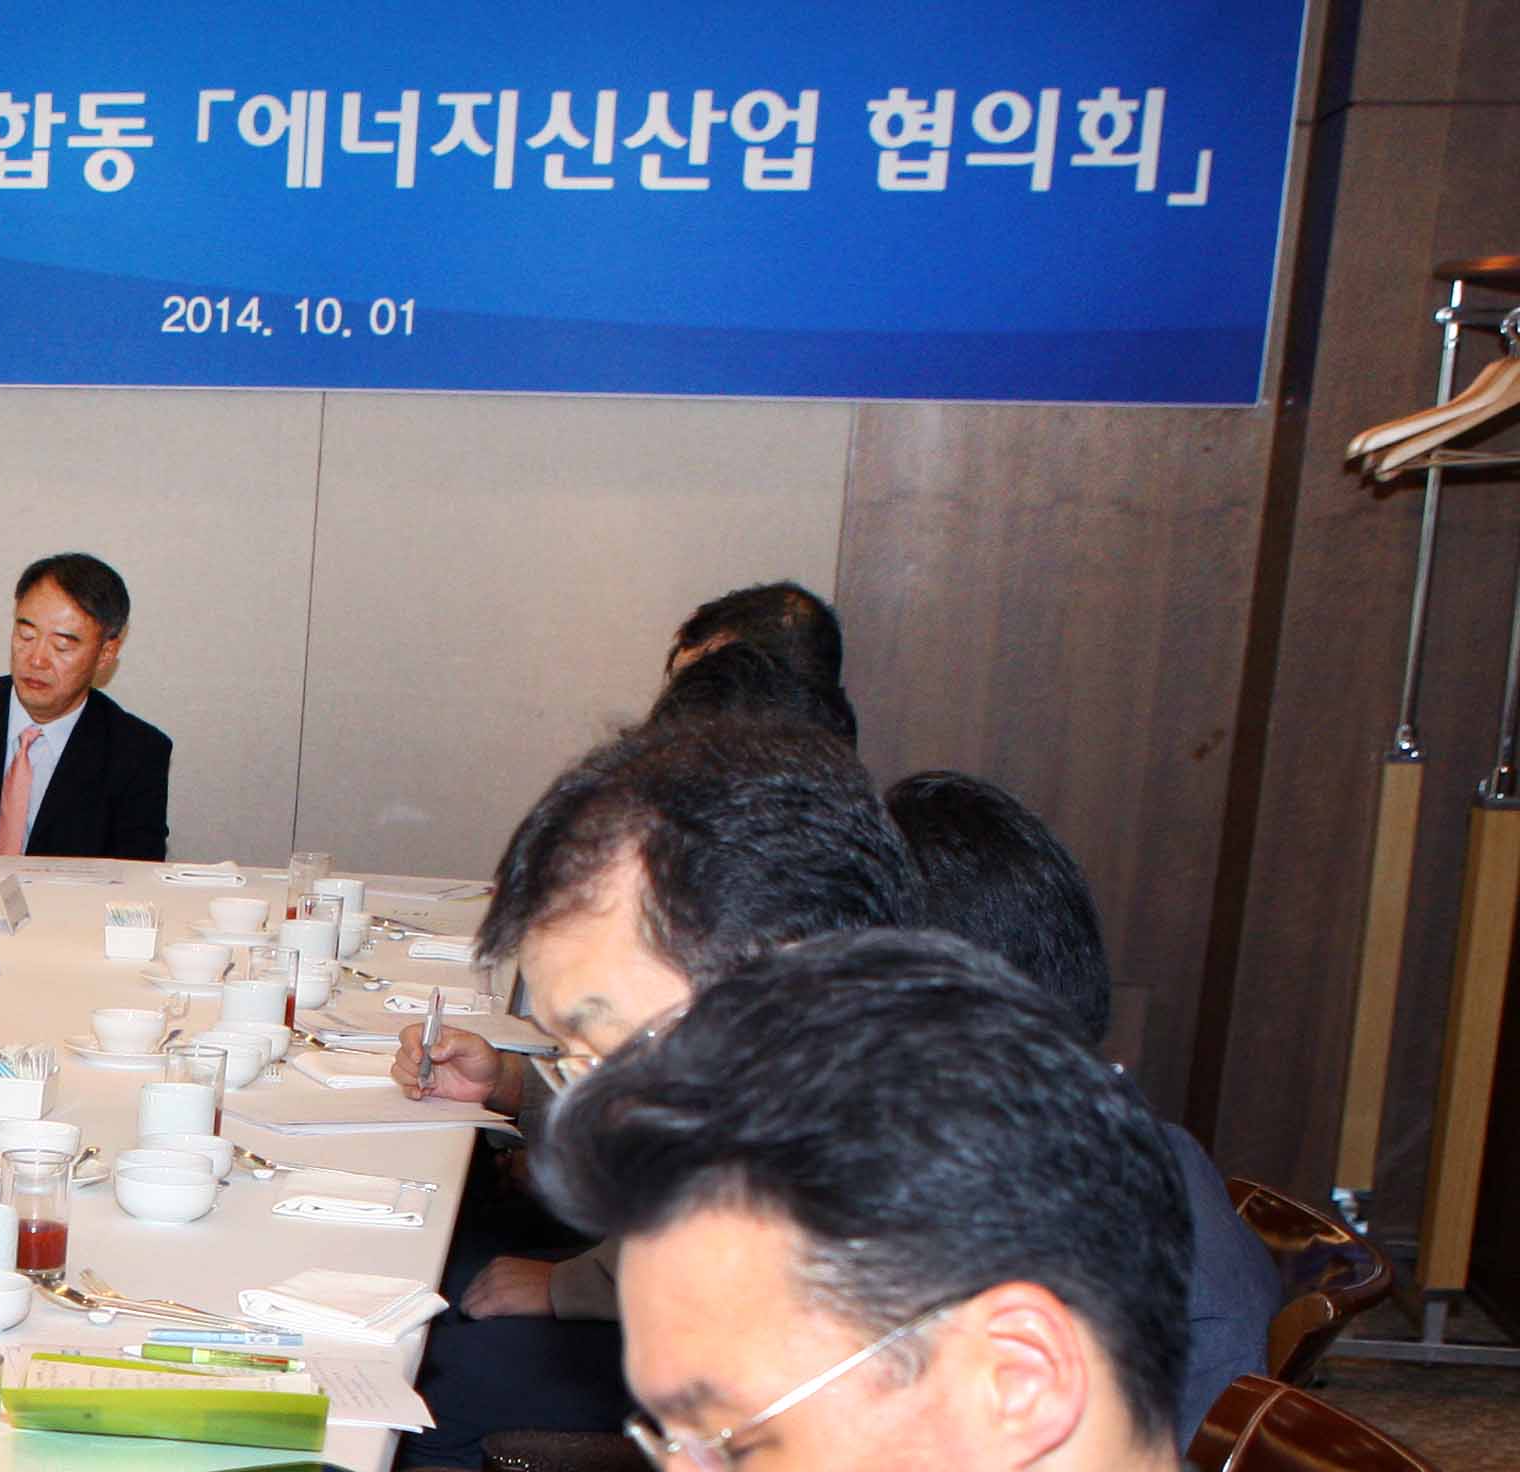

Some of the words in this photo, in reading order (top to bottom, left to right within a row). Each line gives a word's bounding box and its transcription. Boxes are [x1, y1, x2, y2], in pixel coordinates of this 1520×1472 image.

[160, 296, 275, 338] 2014.
[293, 297, 353, 338] 10.
[368, 298, 417, 337] 01
